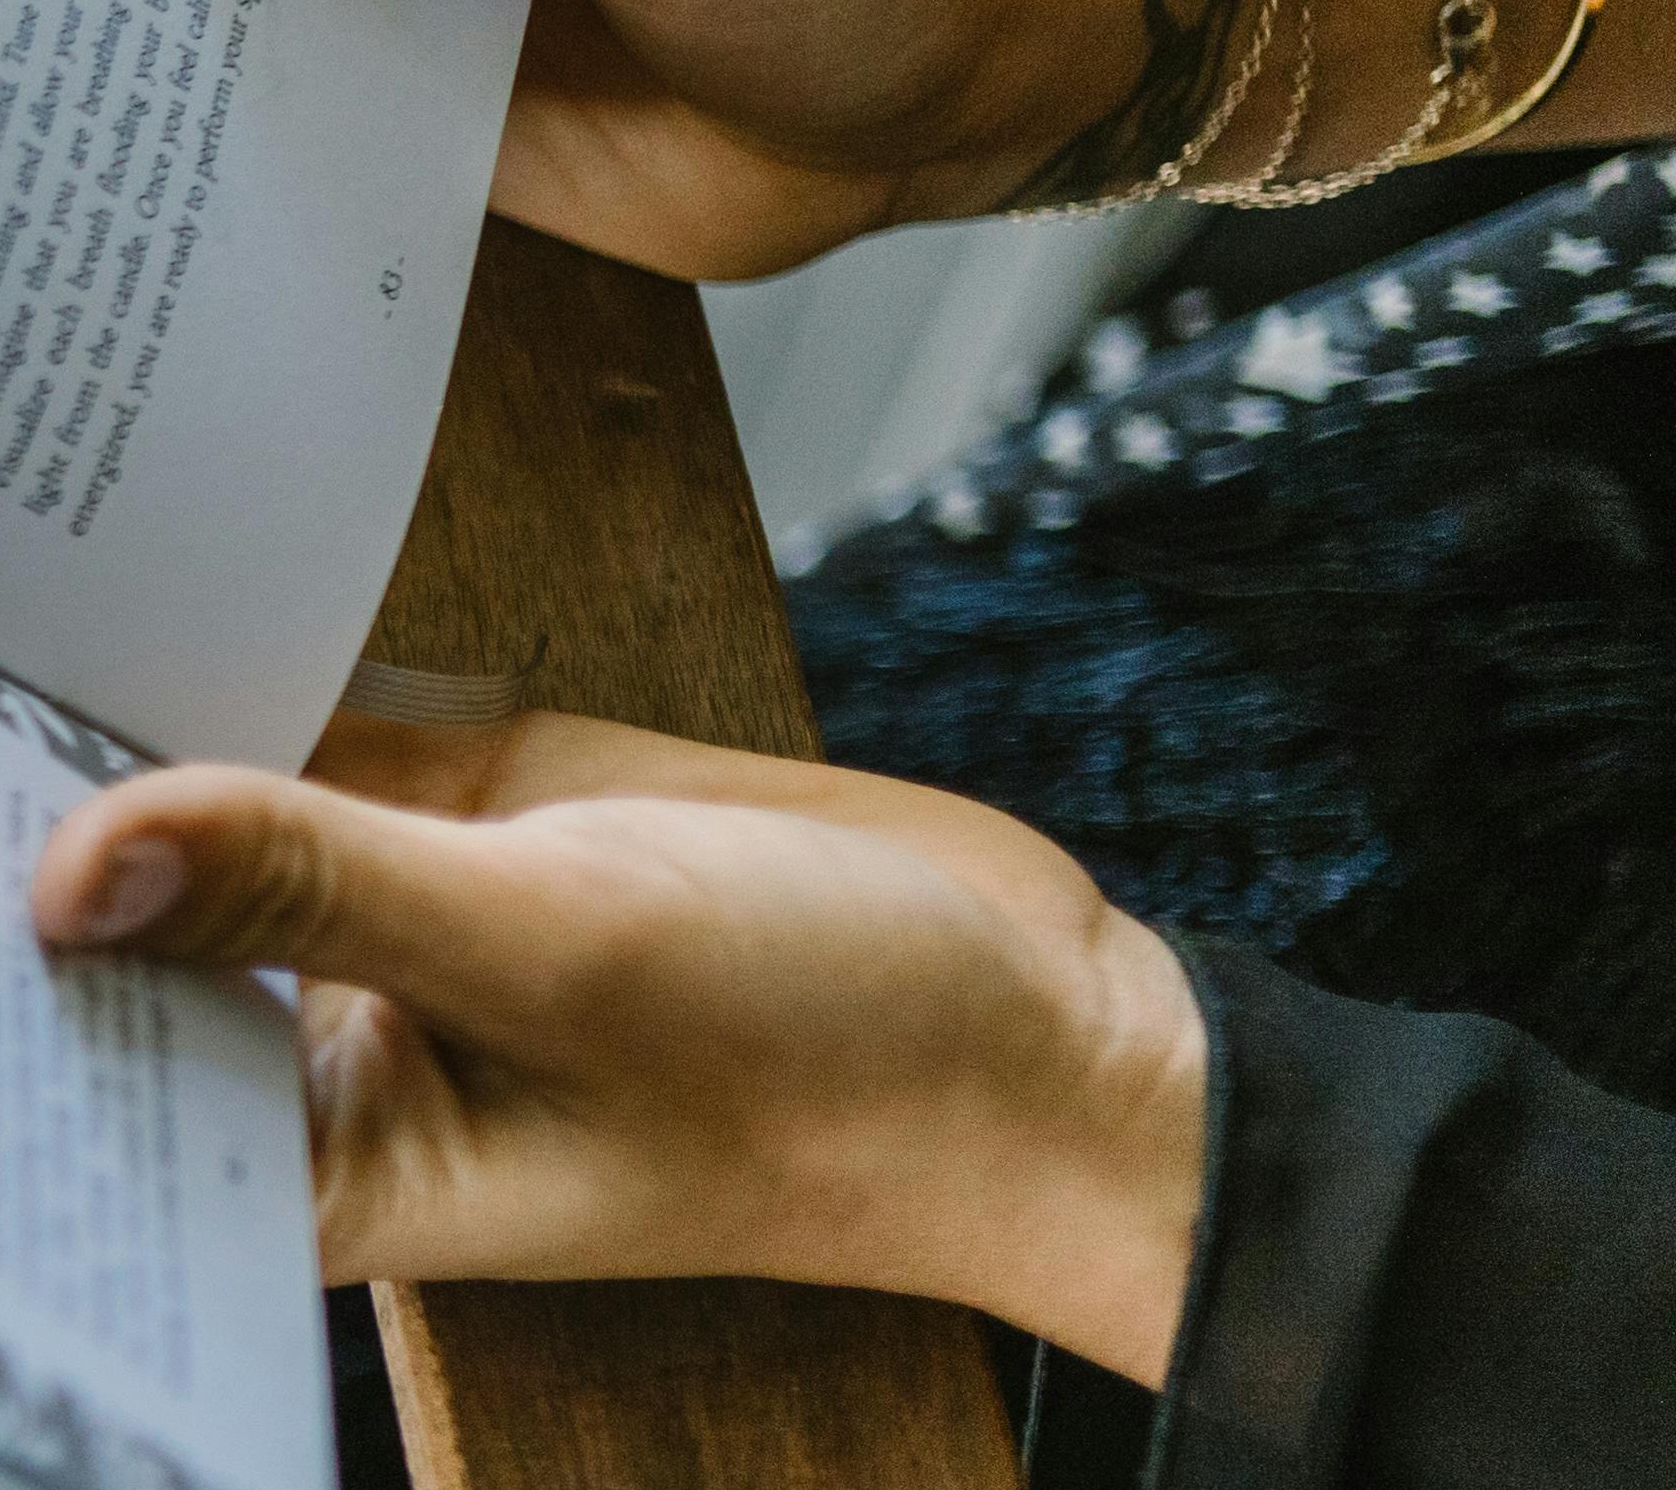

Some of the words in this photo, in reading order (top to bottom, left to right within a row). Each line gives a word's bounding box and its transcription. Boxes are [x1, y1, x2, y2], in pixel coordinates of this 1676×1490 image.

[0, 3, 40, 66] Tune
[73, 0, 132, 117] breathing
[133, 21, 162, 86] your
[221, 12, 248, 77] your
[166, 42, 199, 92] feel
[27, 65, 65, 137] allow
[159, 99, 187, 150] you
[194, 77, 234, 183] perform
[14, 139, 44, 196] and
[66, 126, 93, 170] are
[95, 91, 151, 197] flooding
[46, 179, 78, 234] you
[134, 152, 172, 220] Once
[183, 184, 207, 211] to
[20, 237, 59, 292] that
[63, 207, 114, 291] breath
[109, 234, 151, 319] candle.
[162, 214, 201, 289] ready
[45, 303, 84, 366] each
[84, 326, 119, 370] the
[148, 294, 175, 338] are
[126, 342, 161, 398] you
[52, 379, 102, 448] from
[20, 452, 71, 516] light
[67, 401, 141, 537] energized,
